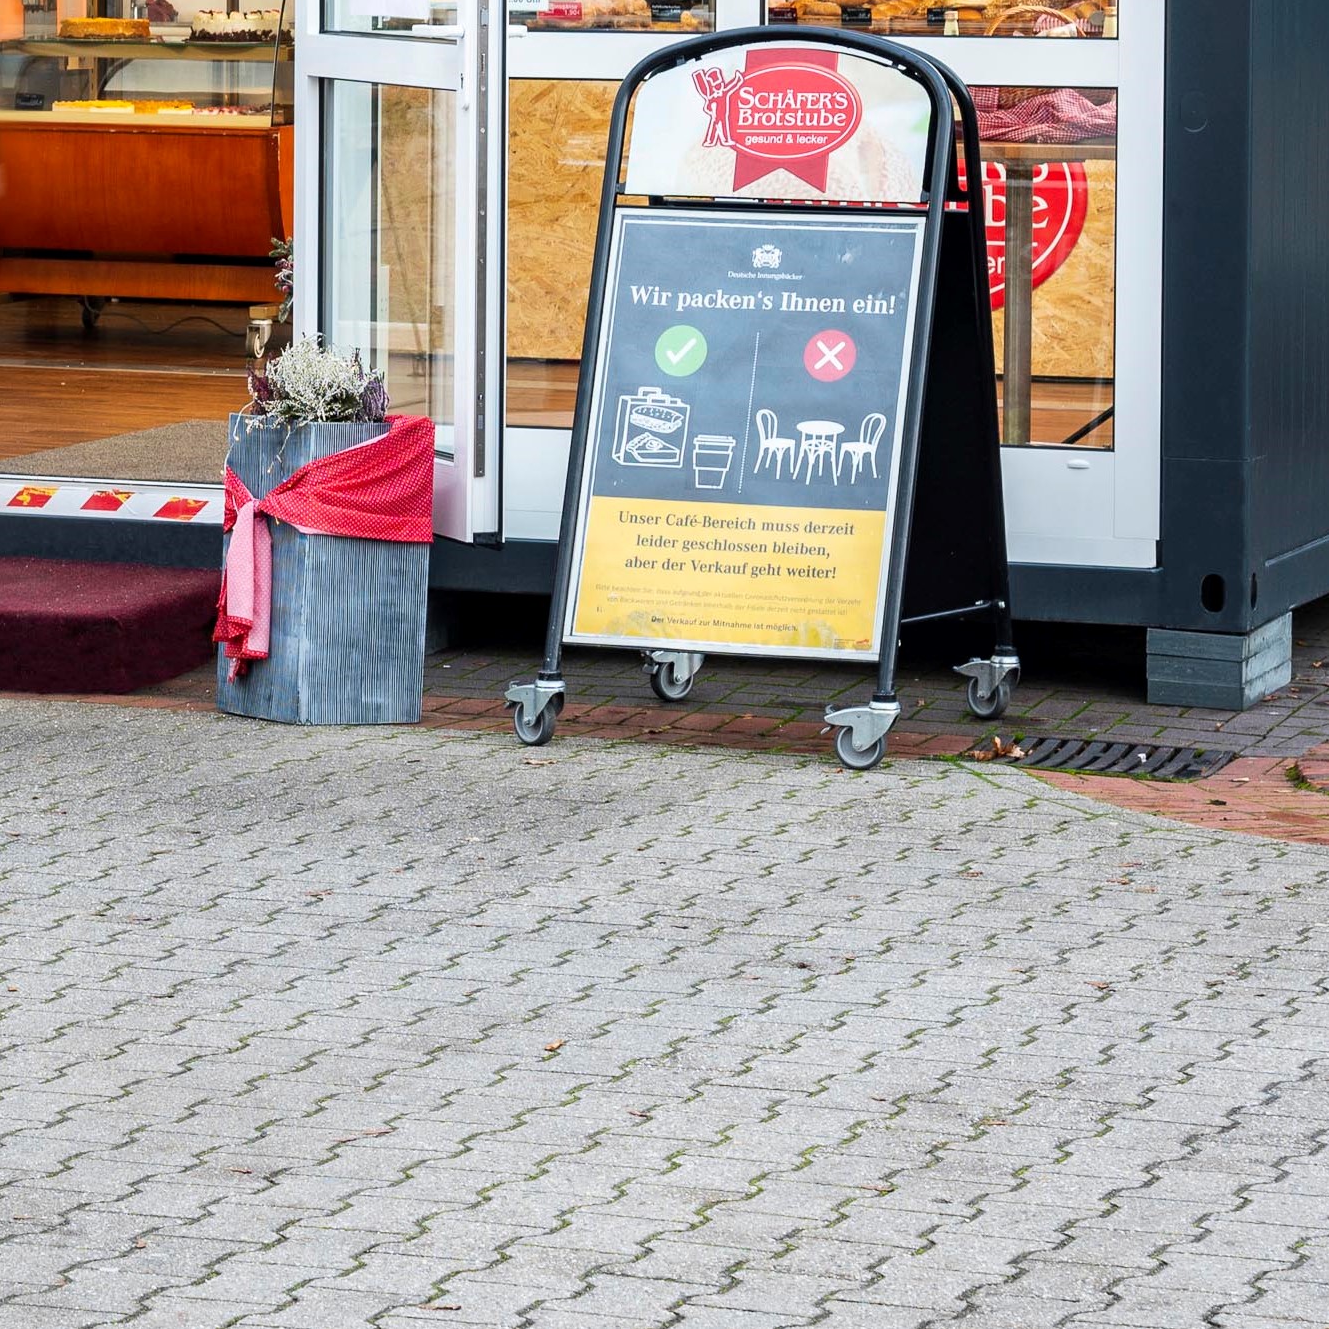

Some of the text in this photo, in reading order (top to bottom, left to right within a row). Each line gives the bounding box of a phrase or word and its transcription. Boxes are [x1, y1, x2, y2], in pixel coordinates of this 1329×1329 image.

[737, 108, 847, 126] Brotstube
[745, 134, 828, 145] gesund & lecker
[727, 270, 756, 279] Deutsche
[630, 285, 672, 306] Wir
[779, 292, 846, 313] Ihnen
[853, 294, 896, 314] ein!
[618, 510, 855, 536] Unser Café-Bereich muss derzeit
[636, 534, 831, 559] leider geschlossen bleiben,
[624, 556, 837, 579] aber der Verkauf geht weiter!
[651, 615, 665, 623] Der
[667, 617, 696, 626] Verkauf
[713, 619, 752, 629] Mitnahme
[754, 622, 764, 630] ist
[766, 623, 798, 632] möglich.
